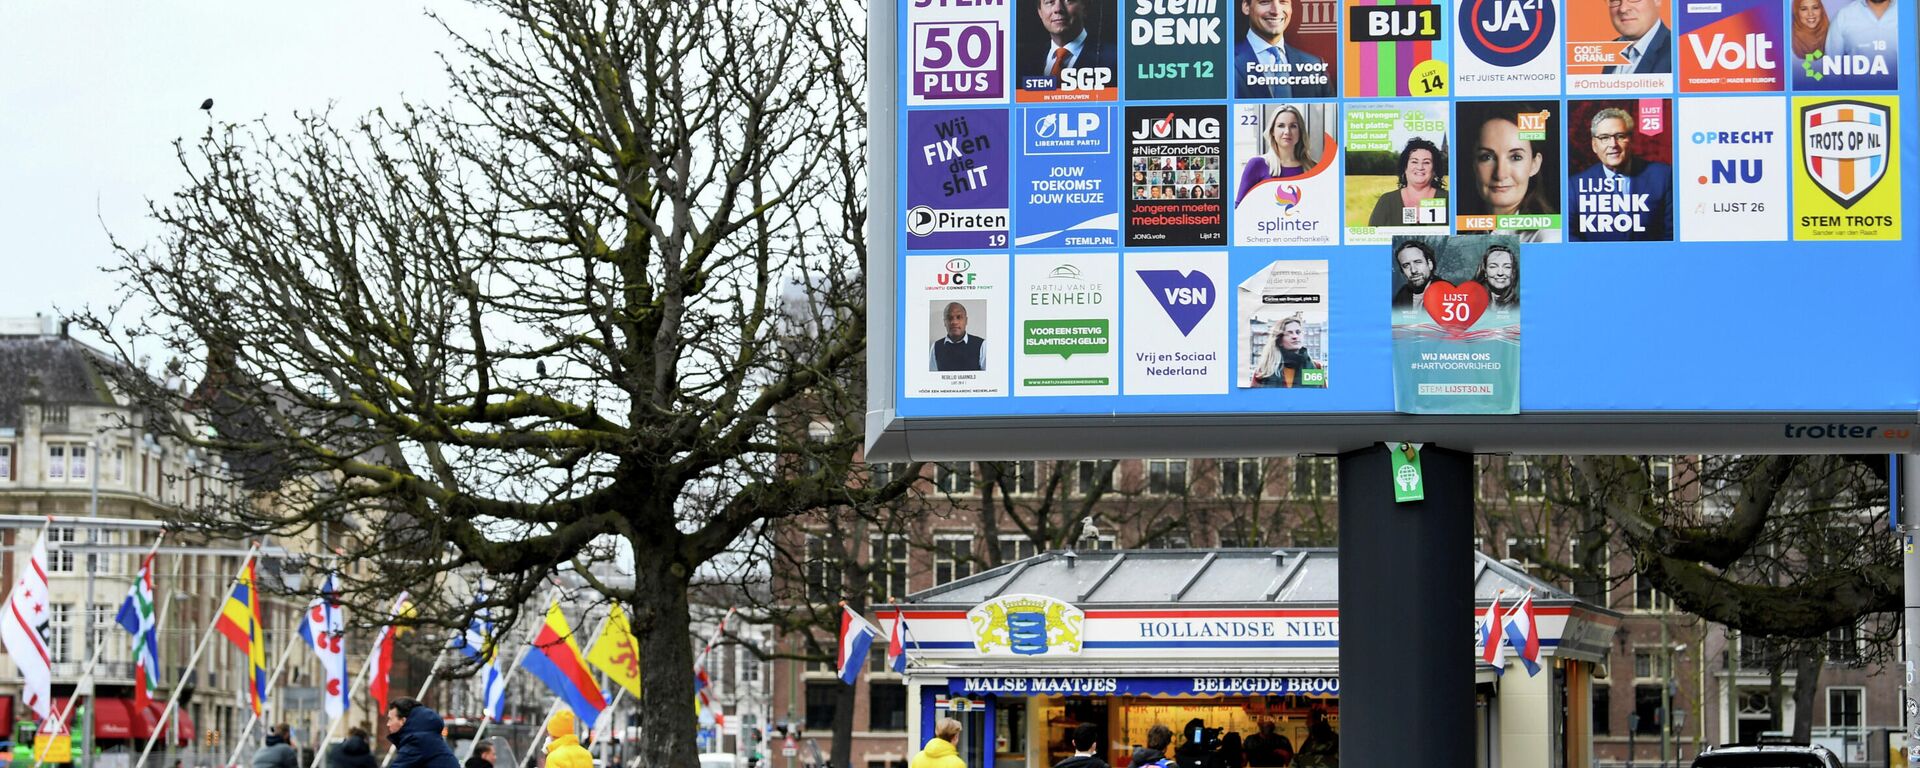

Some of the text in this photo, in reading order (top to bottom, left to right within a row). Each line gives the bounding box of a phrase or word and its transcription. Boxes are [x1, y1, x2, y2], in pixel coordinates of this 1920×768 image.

[1369, 10, 1436, 36] BIJ1
[1131, 17, 1221, 45] DENK
[923, 26, 991, 69] 50
[1574, 46, 1602, 54] CODE
[1872, 40, 1886, 50] 18
[1687, 33, 1776, 70] Volt
[1574, 54, 1615, 62] ORANJE
[1138, 61, 1214, 79] LIJST 12
[1247, 62, 1328, 73] Forum voor
[1822, 55, 1889, 75] NIDA
[924, 73, 989, 92] PLUS
[1026, 67, 1111, 91] STEM SGP
[1247, 74, 1328, 85] Democratie
[1507, 73, 1556, 81] ANTWOORD
[1421, 75, 1444, 93] 14
[1574, 79, 1665, 91] #Ombudspolitiek
[1059, 112, 1100, 138] LP
[1241, 115, 1258, 125] 22
[1520, 115, 1545, 129] NL
[1642, 118, 1660, 130] 25
[935, 116, 969, 140] Wij
[1132, 116, 1220, 139] JONG
[1691, 131, 1774, 144] OPRECHT
[1809, 131, 1881, 151] TROTS OP NL
[923, 133, 990, 166] FIXen
[1133, 145, 1220, 155] #NietZonderOns
[949, 158, 974, 174] die
[1049, 166, 1084, 177] JOUW
[942, 165, 988, 197] shIT
[1032, 179, 1101, 191] TOEKOMST
[1578, 177, 1625, 193] LIJST
[1029, 193, 1104, 205] JOUW KEUZE
[1579, 193, 1650, 213] HENK
[1132, 203, 1220, 215] Jongeren moeten
[1713, 202, 1765, 213] LIJST 26
[939, 212, 1006, 228] Piraten
[1132, 214, 1220, 226] meebeslissen!
[1429, 208, 1436, 222] 1
[1801, 215, 1893, 227] STEM TROTS
[1257, 217, 1319, 234] splinter
[1466, 217, 1551, 228] KIES GEZOND
[1579, 214, 1646, 233] KROL
[989, 235, 1006, 246] 19
[1065, 237, 1114, 245] STEMLP.NL
[1200, 232, 1212, 240] Lijst
[1283, 235, 1329, 243] onafhankelijk
[937, 273, 977, 285] UCF
[1031, 284, 1063, 292] PARTIJ
[1090, 283, 1102, 291] DE
[1031, 292, 1102, 305] EENHEID
[1164, 288, 1207, 305] VSN
[1443, 293, 1468, 301] LIJST
[1441, 302, 1470, 321] 30
[1054, 327, 1071, 335] EEN
[1072, 327, 1102, 335] STEVIG
[1026, 337, 1107, 346] ISLAMITISCH GELUID
[1136, 352, 1216, 364] Vrij en Sociaal
[1421, 353, 1438, 361] WIJ
[1439, 353, 1470, 361] MAKEN
[1146, 366, 1207, 376] Nederland
[1411, 362, 1502, 370] #HARTVOORVRIJHEID
[1304, 373, 1322, 381] D66
[1445, 385, 1491, 393] LIJST30.NL
[1784, 423, 1910, 439] trotter.eu
[1139, 621, 1339, 638] HOLLANDSE NIEU
[964, 678, 1117, 692] MALSE MAATJES
[1192, 678, 1340, 692] BELEGDE BROO
